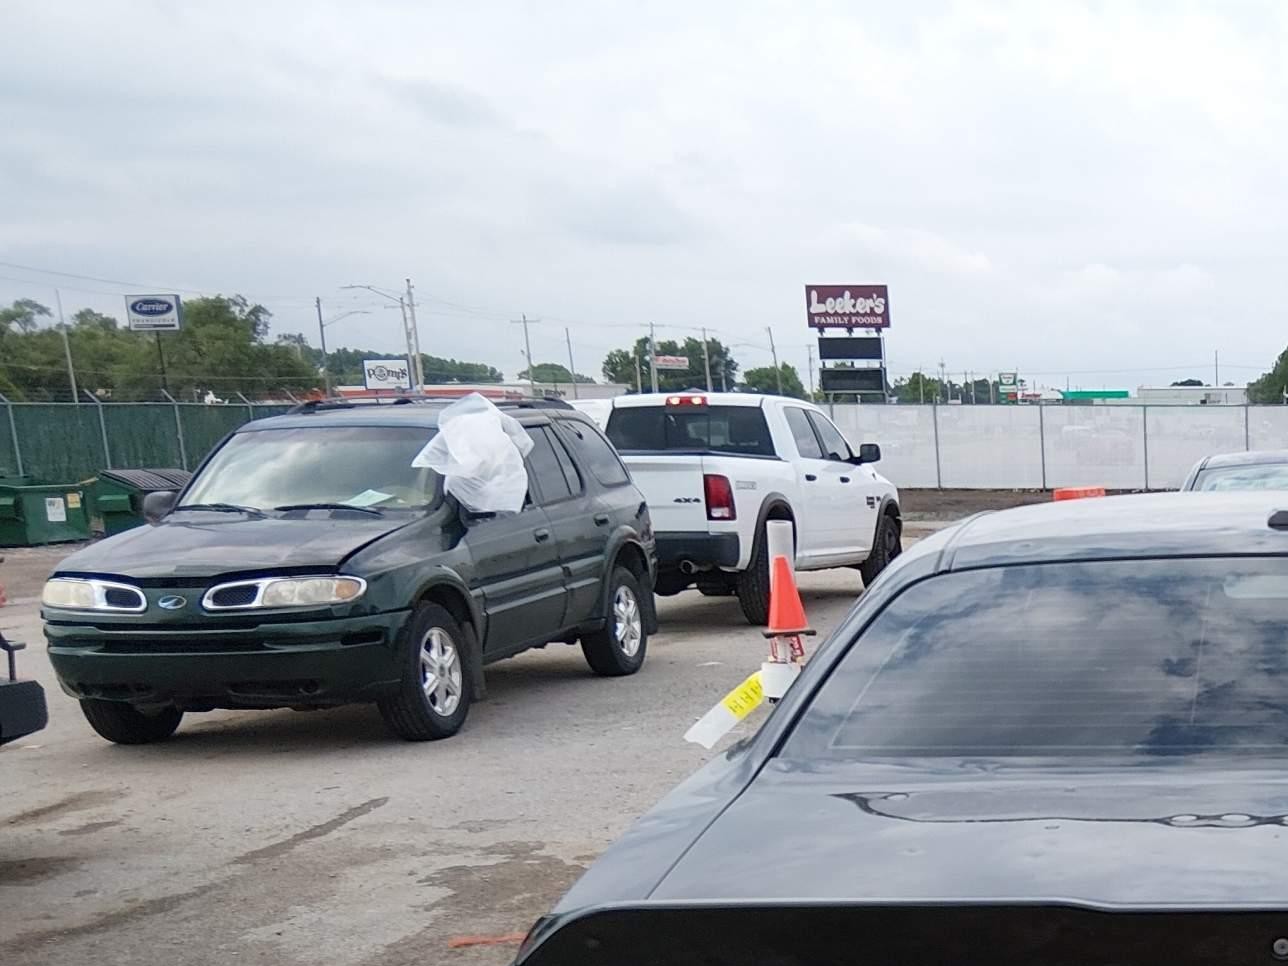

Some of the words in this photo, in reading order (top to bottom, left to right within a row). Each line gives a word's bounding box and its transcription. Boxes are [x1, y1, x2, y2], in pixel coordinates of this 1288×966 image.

[135, 302, 170, 313] Carrier
[809, 290, 886, 314] Leeker's
[814, 316, 849, 324] FAMILY
[851, 316, 883, 324] FOODS
